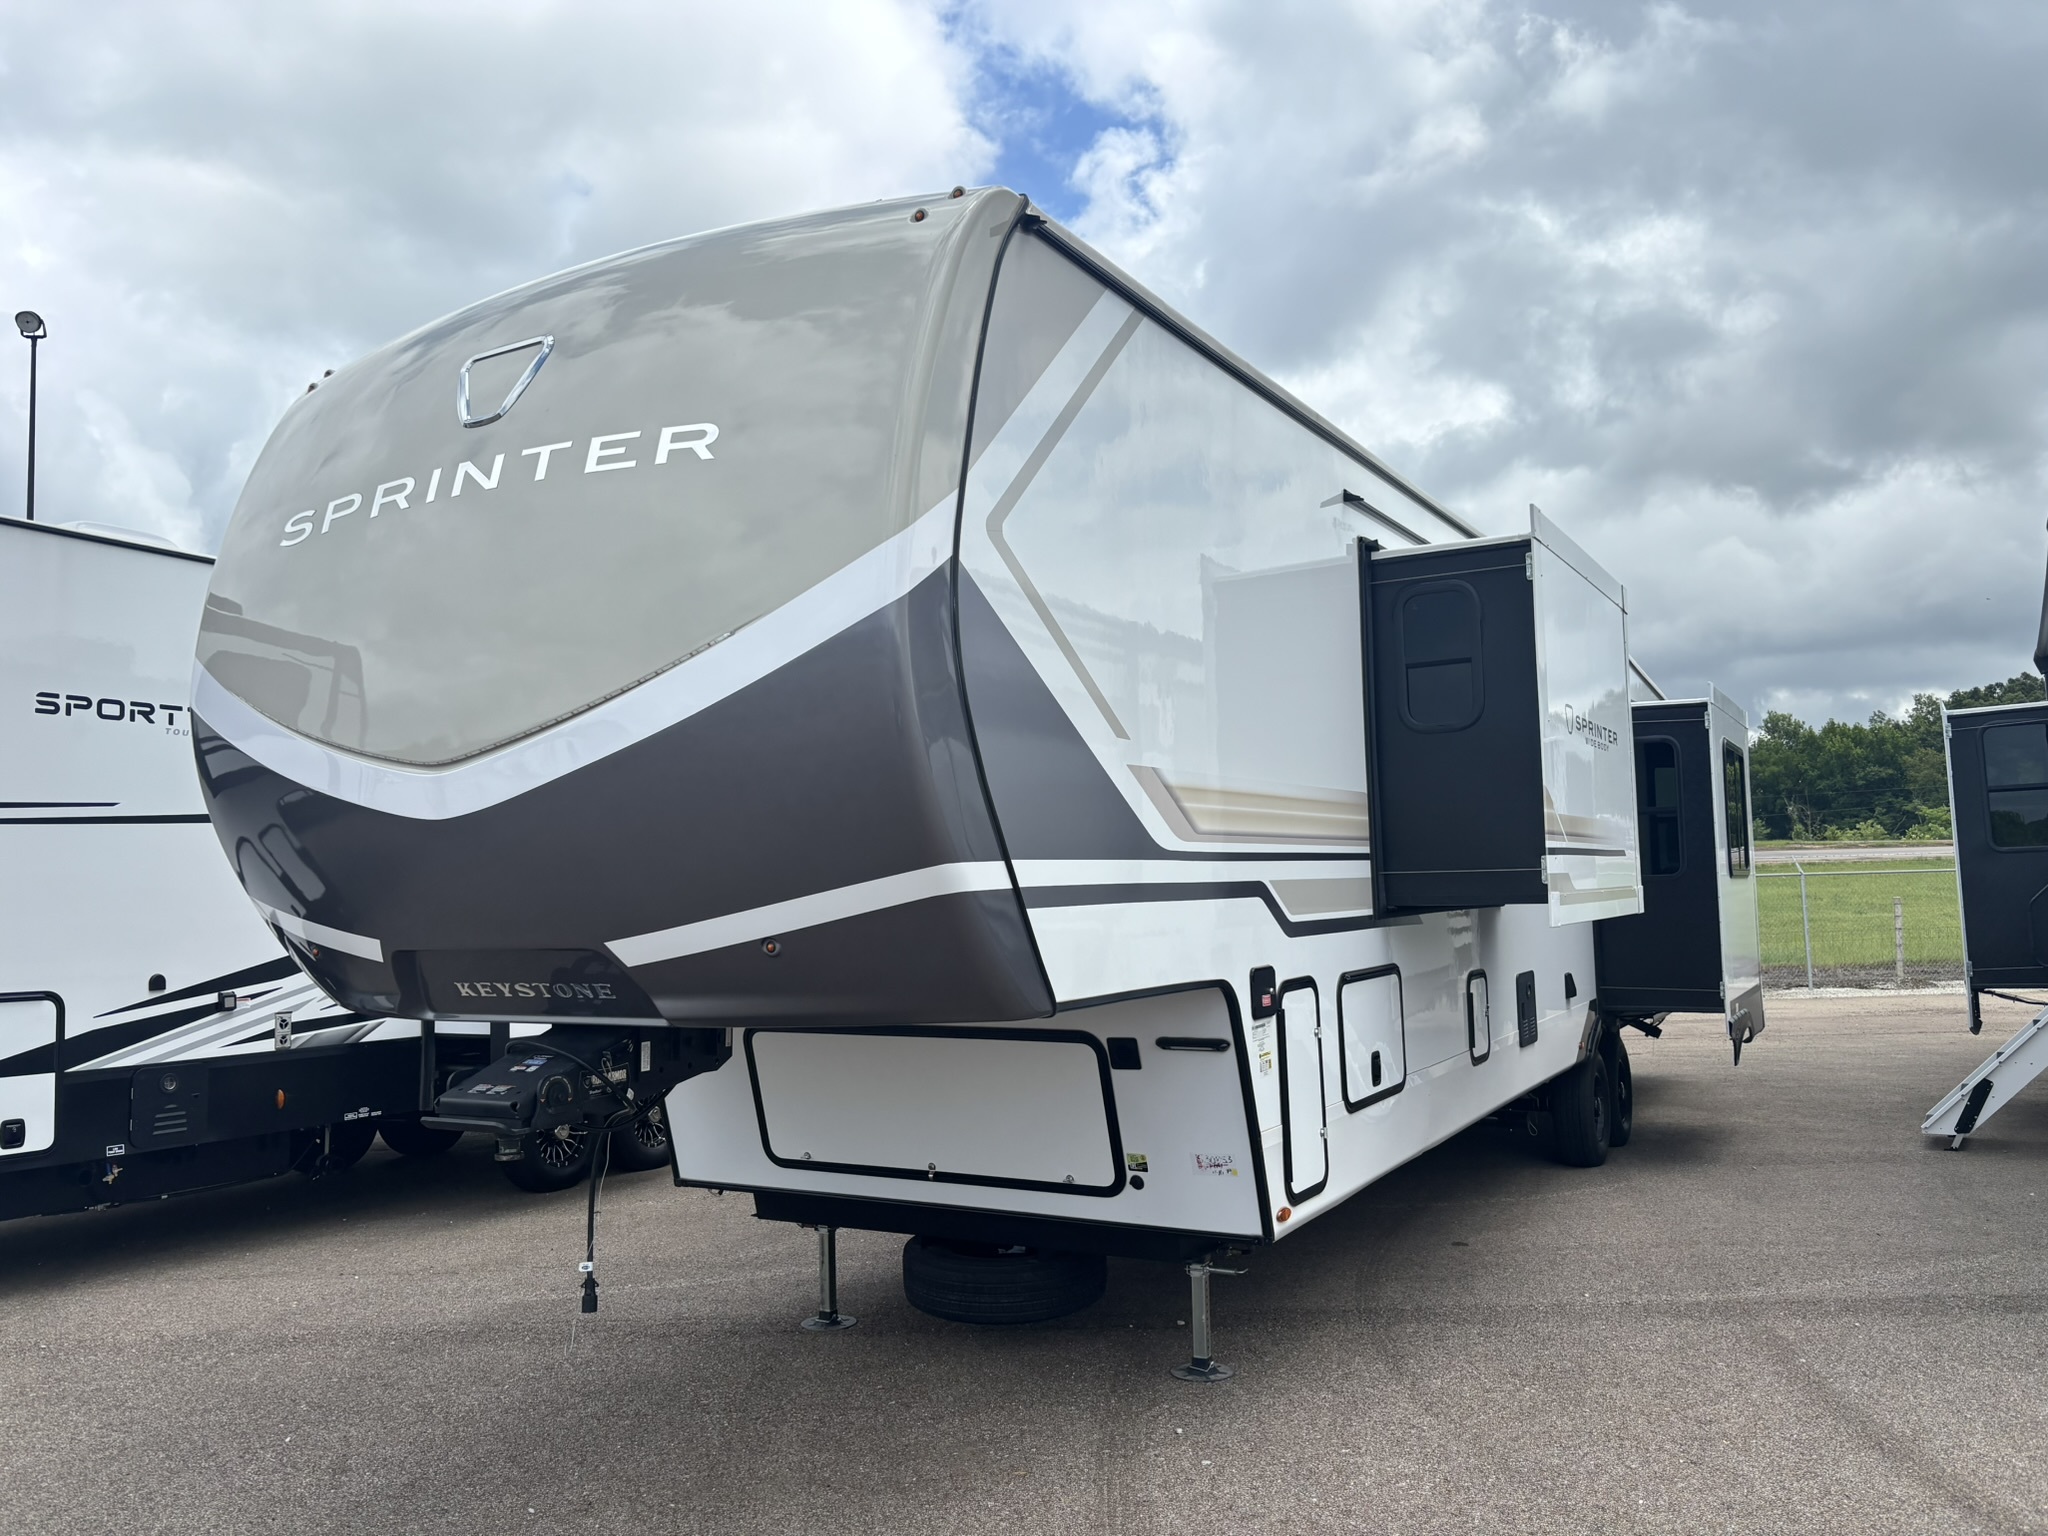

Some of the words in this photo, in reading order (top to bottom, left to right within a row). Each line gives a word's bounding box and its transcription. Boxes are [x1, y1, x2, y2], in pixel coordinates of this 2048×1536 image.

[279, 421, 721, 548] SPRINTER
[34, 691, 192, 726] SPORT
[1575, 715, 1618, 746] SPRINTER
[1597, 741, 1609, 752] BODY
[453, 981, 617, 999] KEYSTONE
